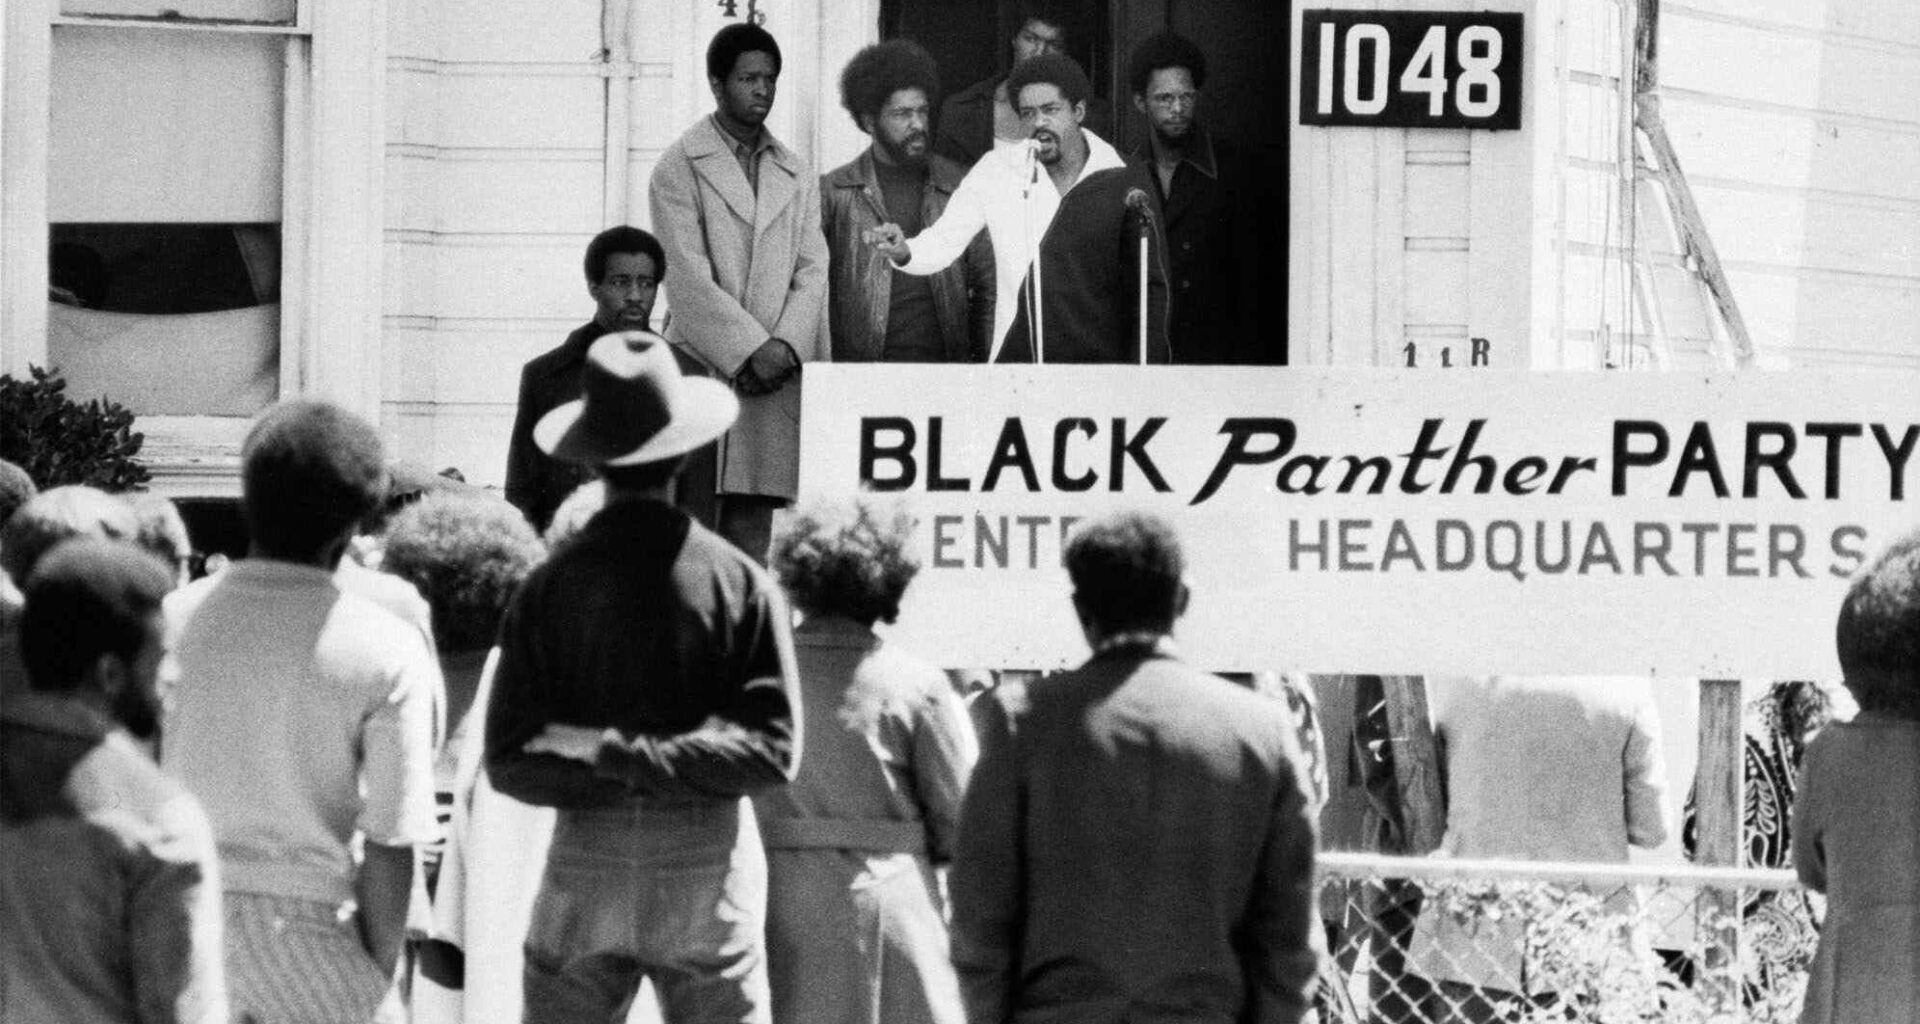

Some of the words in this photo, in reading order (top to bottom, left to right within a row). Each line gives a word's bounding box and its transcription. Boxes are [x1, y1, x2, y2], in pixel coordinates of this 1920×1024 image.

[1317, 22, 1503, 117] 1048
[859, 416, 1175, 492] BLACK
[1188, 417, 1597, 506] Panther
[1611, 420, 1920, 500] PARTY
[1289, 519, 1868, 582] HEADQUARTERS
